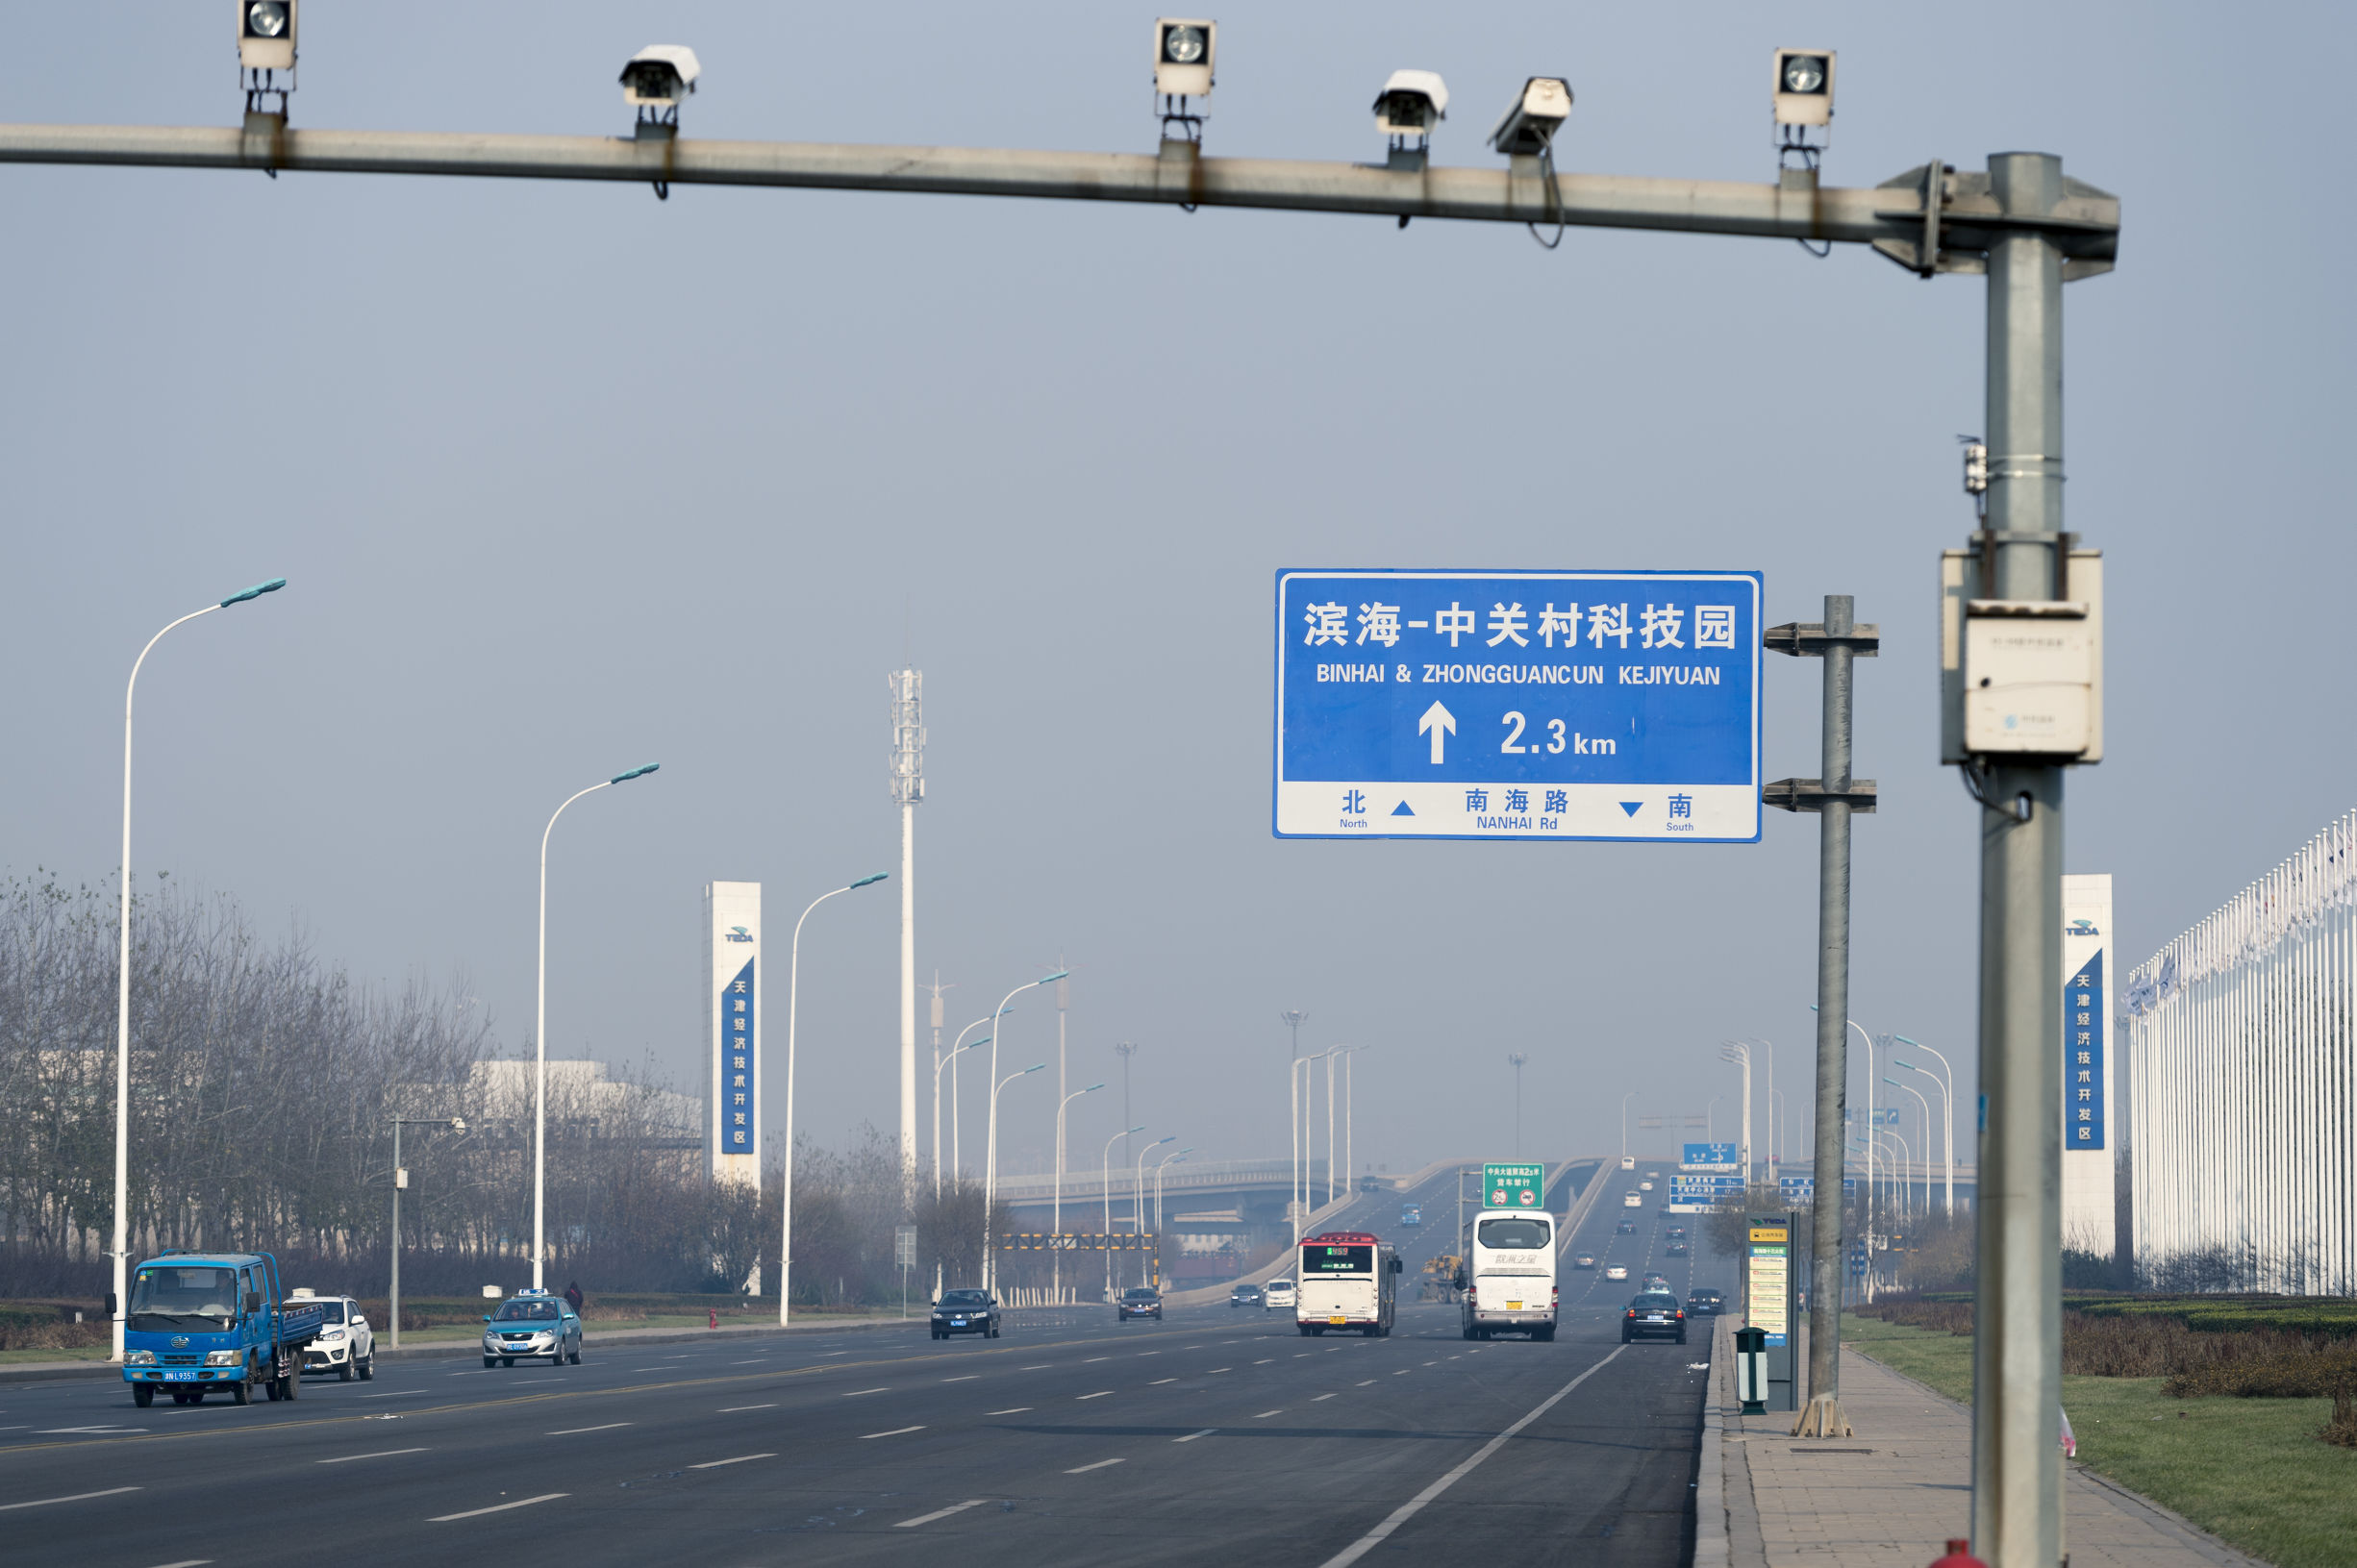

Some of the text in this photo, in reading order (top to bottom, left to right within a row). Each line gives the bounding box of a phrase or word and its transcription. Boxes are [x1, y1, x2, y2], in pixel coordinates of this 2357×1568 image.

[1303, 602, 1736, 649] 滨海-中关村科技园
[1316, 664, 1720, 685] BINHAI & ZHONGGUANCUN KEJIYUAN
[1501, 710, 1617, 755] 2.3 km
[1341, 789, 1367, 814] 北
[1466, 788, 1568, 814] 南海路
[1667, 793, 1693, 818] 南
[1340, 818, 1367, 828] North
[1477, 816, 1558, 830] NANHAI Rd
[1667, 822, 1693, 832] South
[725, 933, 754, 943] TEDA
[2066, 928, 2099, 936] TEDA
[733, 981, 746, 1145] 天津经济技术开发区
[2077, 975, 2092, 1141] 天津经济技术开发区
